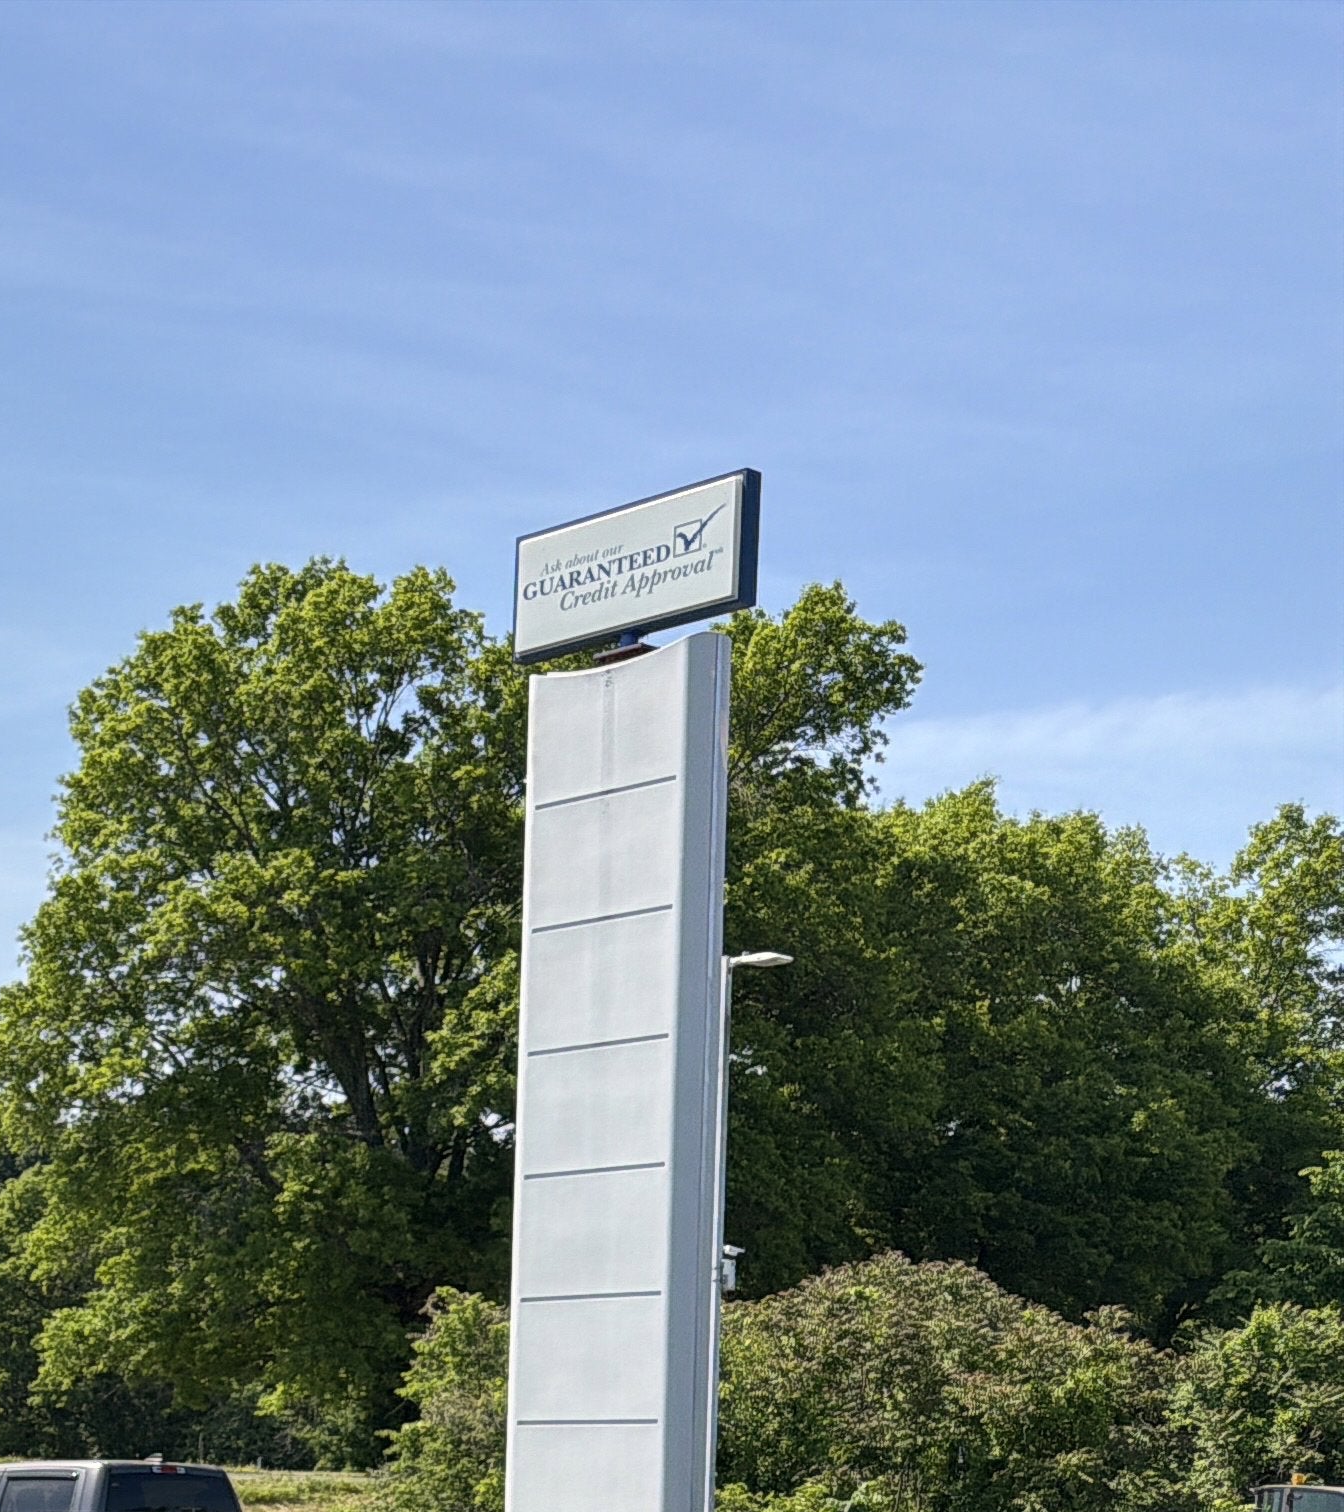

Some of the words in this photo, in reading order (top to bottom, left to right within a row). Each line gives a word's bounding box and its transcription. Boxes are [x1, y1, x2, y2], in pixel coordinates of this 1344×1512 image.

[522, 544, 671, 601] GUARANTEED
[540, 559, 562, 577] Ask
[565, 549, 599, 570] about
[602, 544, 624, 558] our
[560, 579, 618, 612] Credit
[621, 550, 714, 598] Approval
